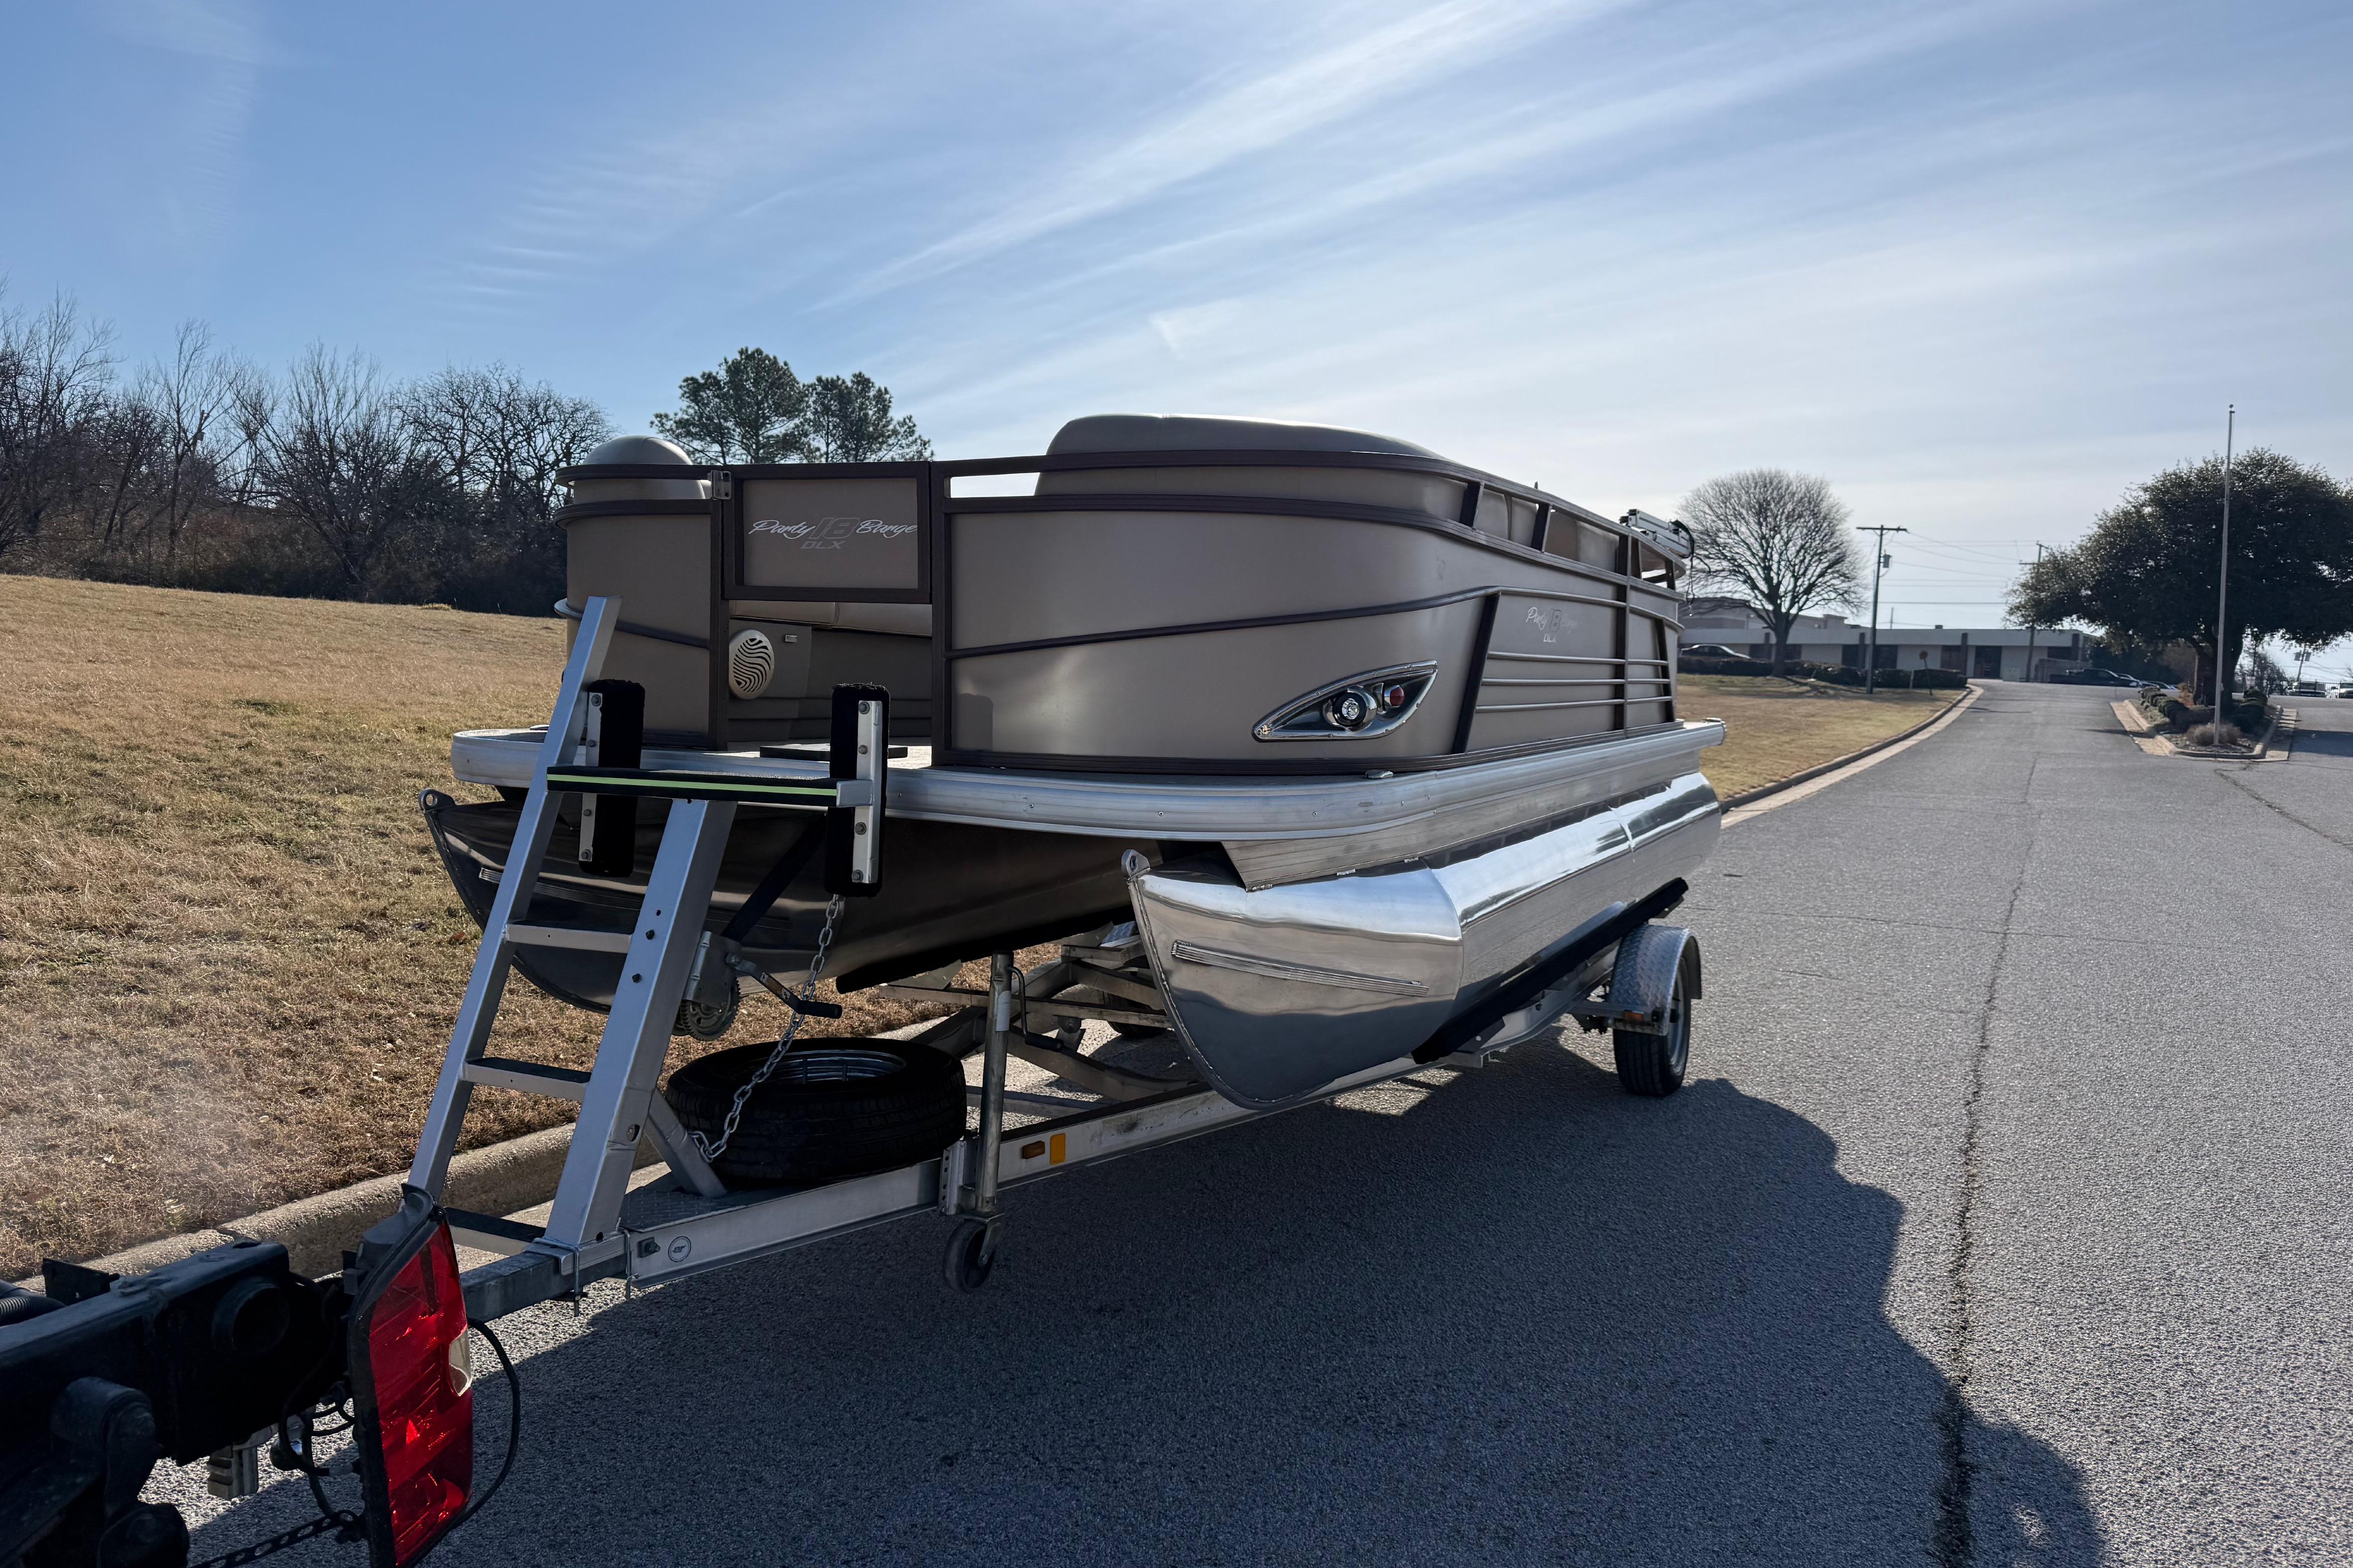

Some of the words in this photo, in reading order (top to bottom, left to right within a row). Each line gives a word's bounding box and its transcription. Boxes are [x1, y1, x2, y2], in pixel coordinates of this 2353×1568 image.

[748, 519, 816, 539] Party
[808, 517, 860, 539] 18
[856, 519, 918, 539] Barge
[800, 540, 846, 549] DLX
